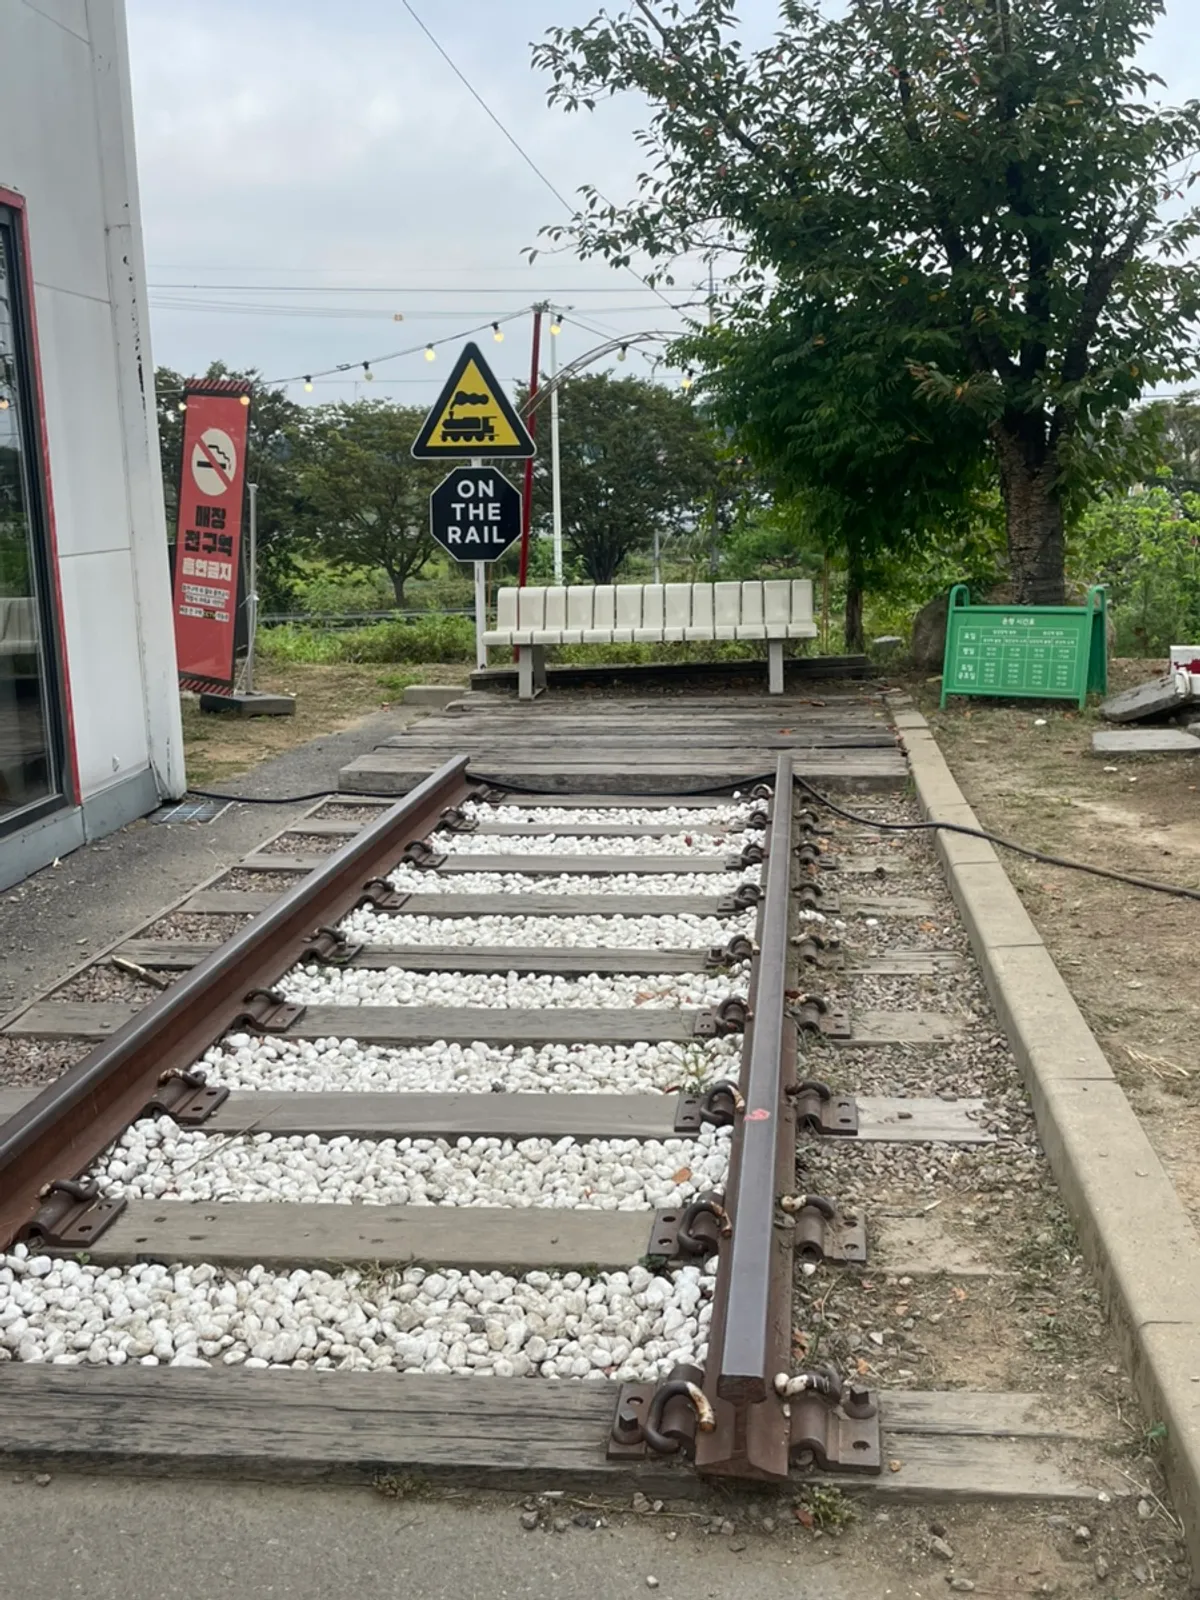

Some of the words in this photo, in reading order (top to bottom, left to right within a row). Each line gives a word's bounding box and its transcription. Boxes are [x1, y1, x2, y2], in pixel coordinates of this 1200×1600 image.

[457, 480, 494, 498] ON
[195, 505, 226, 530] 매장
[451, 503, 501, 521] THE
[448, 526, 506, 544] RAIL
[182, 557, 232, 582] 흡연금지
